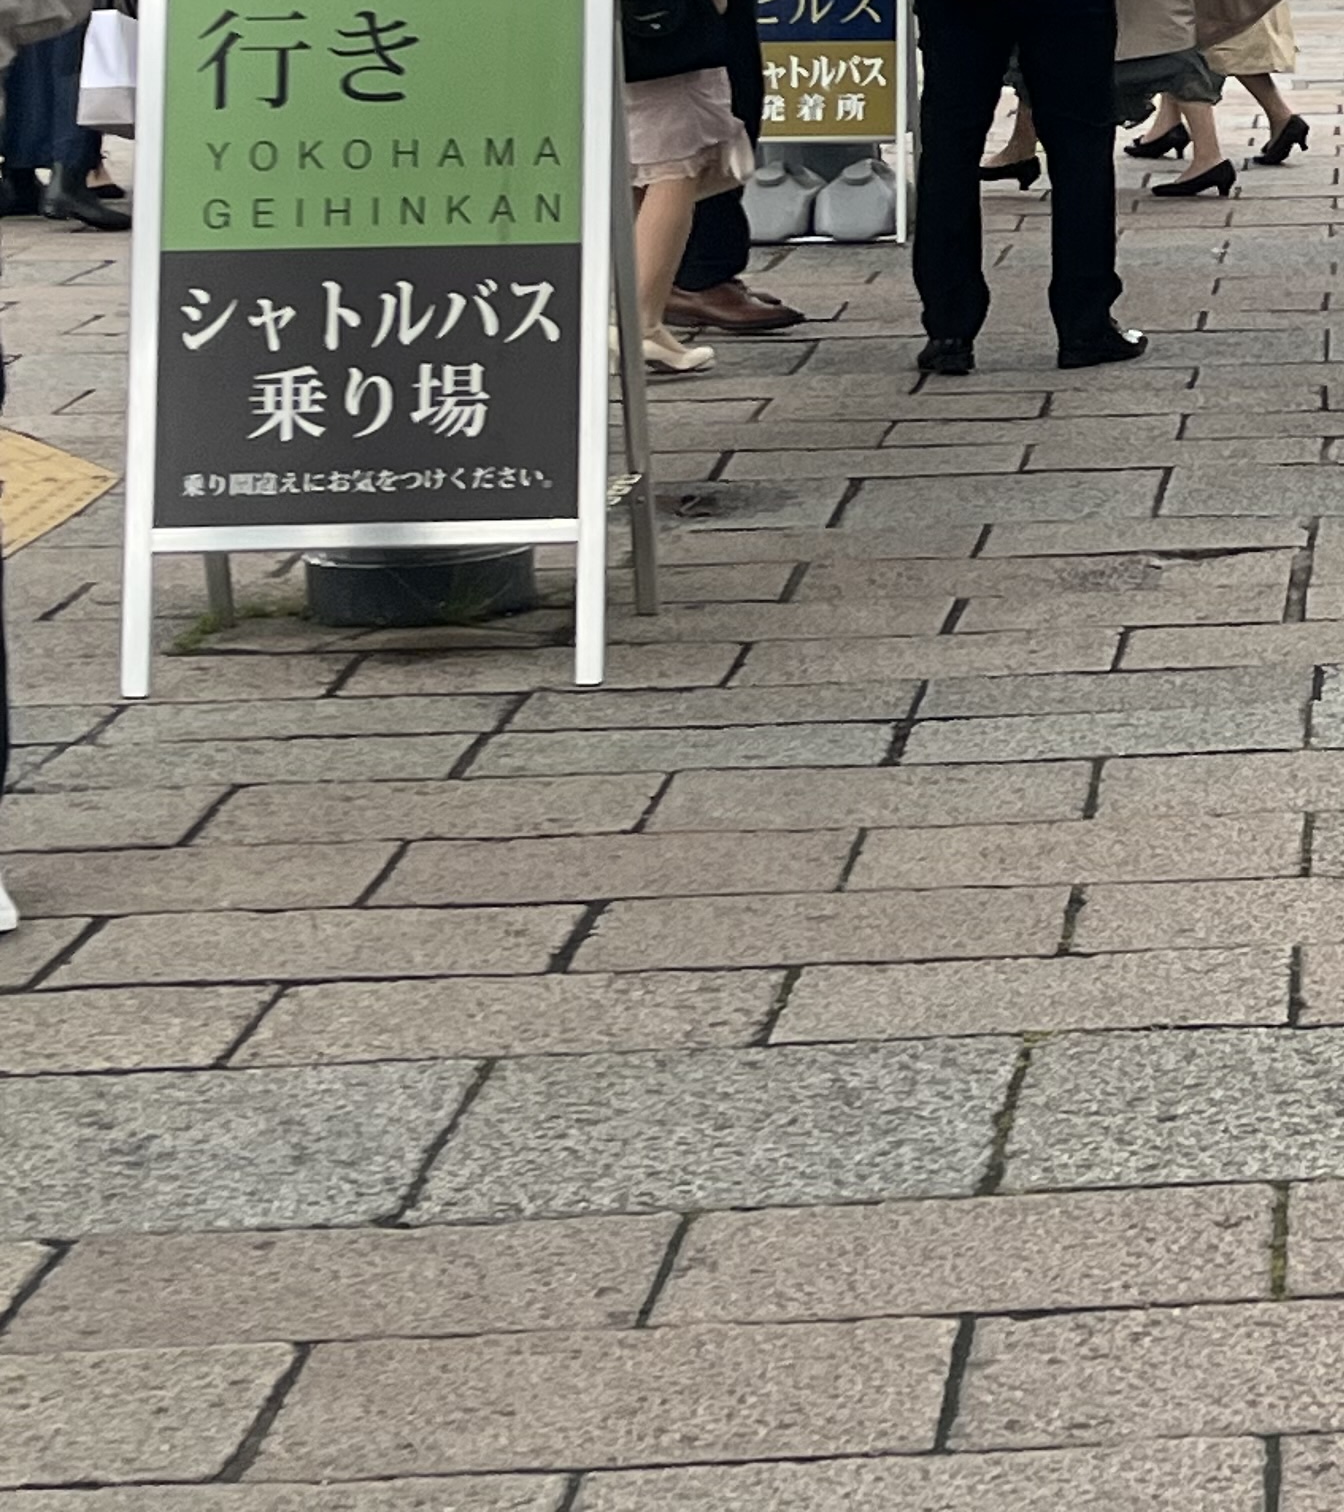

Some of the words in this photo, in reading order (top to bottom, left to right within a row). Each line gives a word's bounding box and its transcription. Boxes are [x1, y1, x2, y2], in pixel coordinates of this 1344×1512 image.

[198, 9, 420, 108] 行き
[763, 54, 886, 90] ャトルバス
[206, 136, 562, 172] YOKOHAMA
[203, 193, 564, 230] GEIHINKAN
[180, 279, 562, 351] シャトルバス
[246, 363, 491, 441] 乗り場
